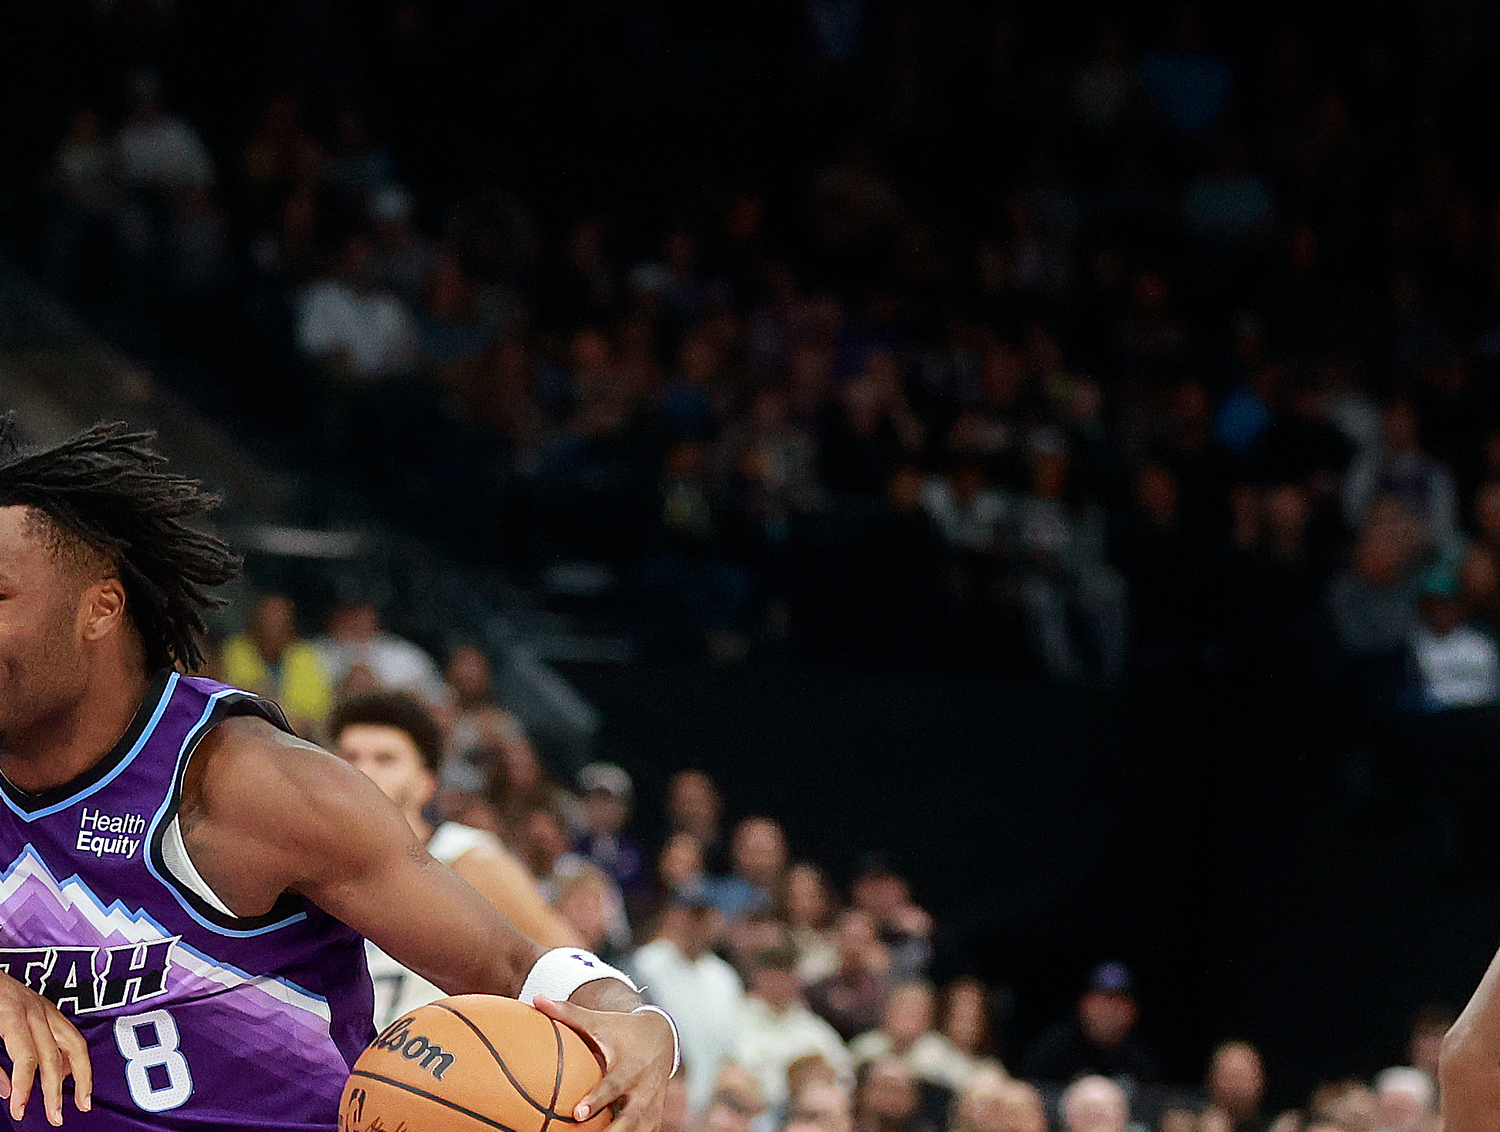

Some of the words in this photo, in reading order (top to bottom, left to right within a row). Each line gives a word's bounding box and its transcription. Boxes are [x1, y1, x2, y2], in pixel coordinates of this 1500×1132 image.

[80, 807, 146, 834] Health
[76, 830, 141, 859] Equity
[113, 1009, 193, 1112] 8
[370, 1017, 456, 1081] lson
